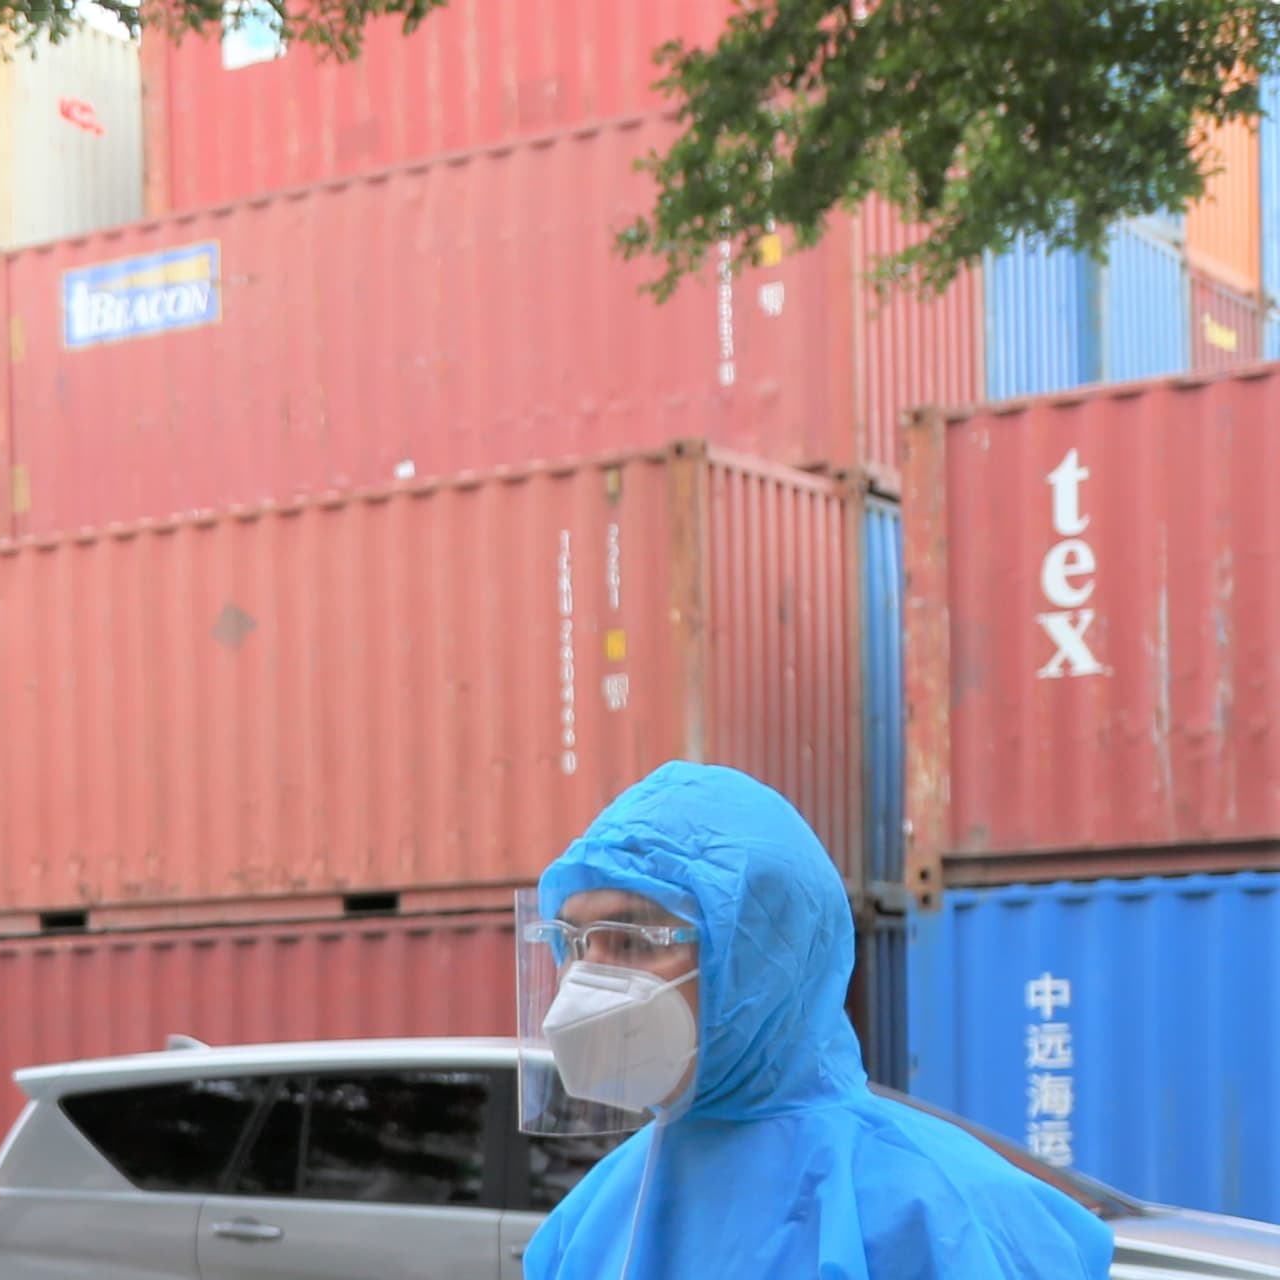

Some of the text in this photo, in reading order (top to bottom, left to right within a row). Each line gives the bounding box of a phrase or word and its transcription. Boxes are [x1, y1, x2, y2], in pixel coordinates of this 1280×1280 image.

[1037, 448, 1104, 679] tex
[1024, 972, 1073, 1168] 中远海运
